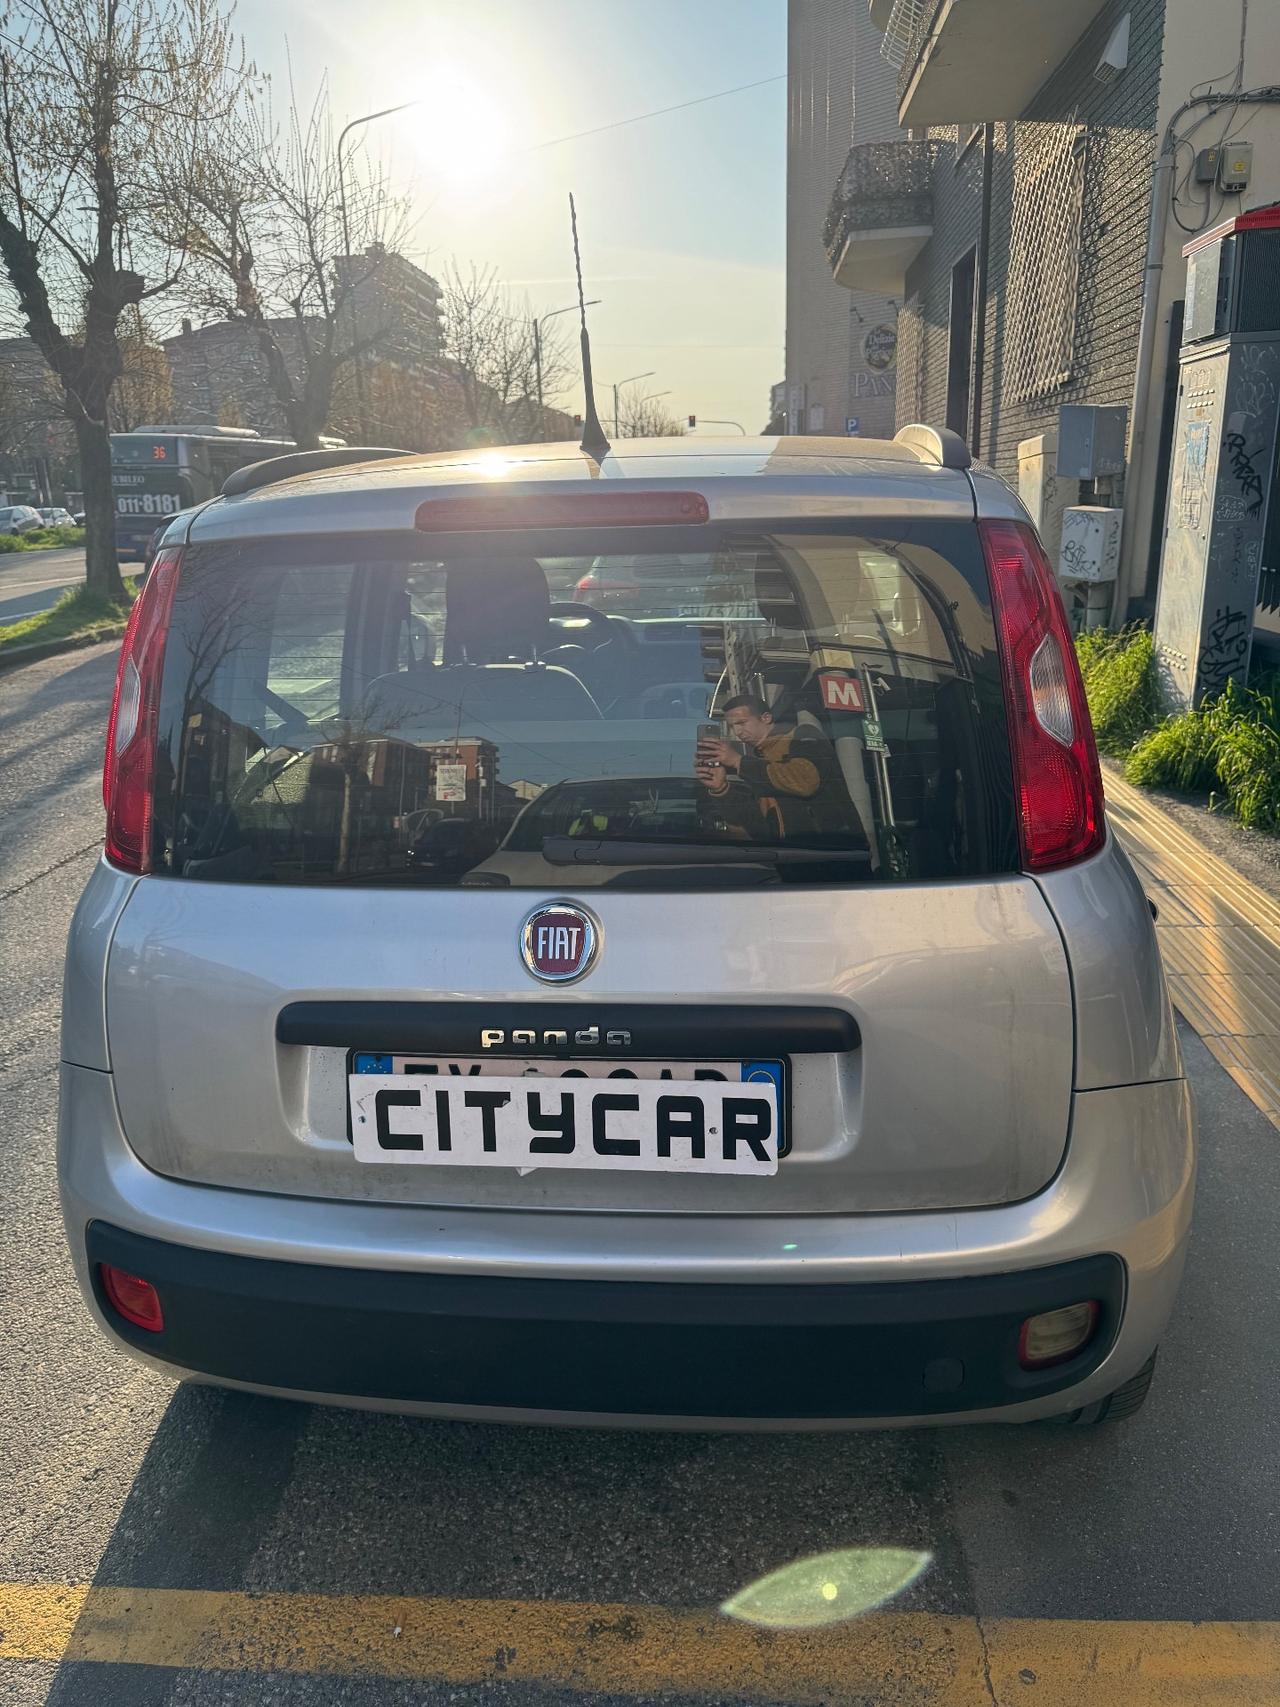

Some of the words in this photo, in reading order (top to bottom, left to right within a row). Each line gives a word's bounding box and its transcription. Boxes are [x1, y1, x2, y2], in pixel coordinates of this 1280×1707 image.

[848, 419, 857, 433] P
[153, 446, 166, 459] 36
[538, 926, 581, 960] FIAT
[481, 1026, 632, 1048] panda
[375, 1089, 772, 1161] CITYCAR
